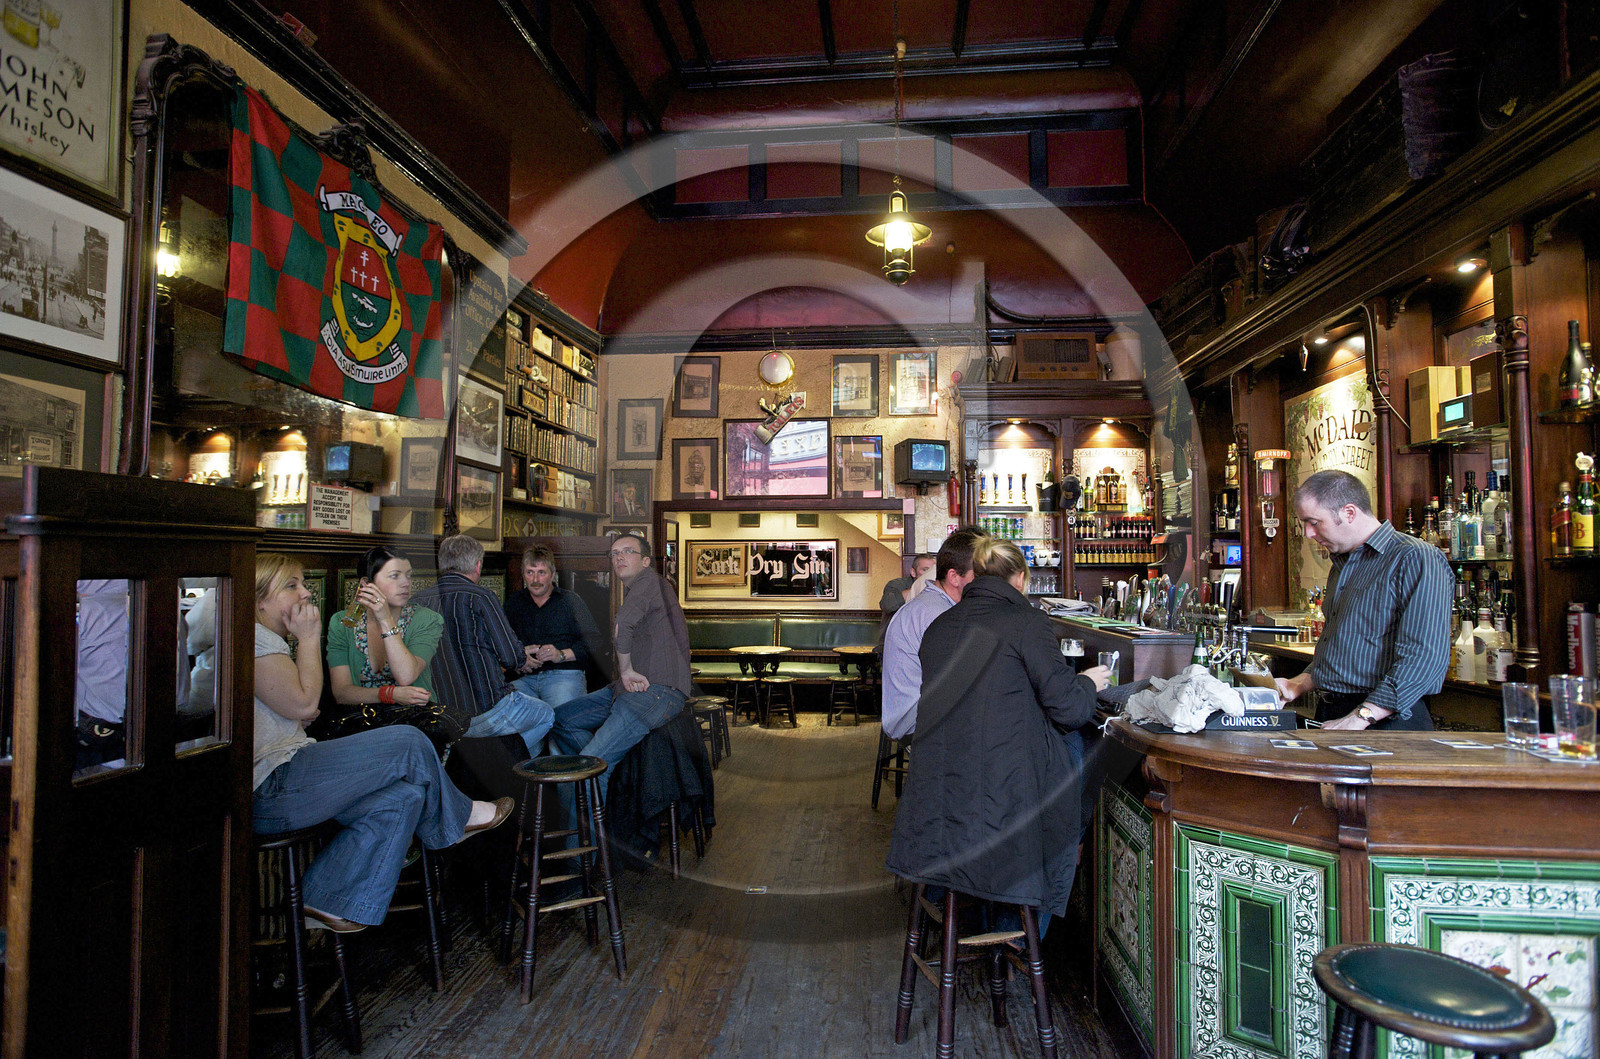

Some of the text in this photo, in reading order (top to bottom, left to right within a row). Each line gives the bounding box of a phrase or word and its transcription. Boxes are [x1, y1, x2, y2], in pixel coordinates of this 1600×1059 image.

[370, 216, 388, 236] EO
[766, 396, 804, 433] TOILETS
[1341, 445, 1373, 471] STREET
[697, 551, 826, 582] Cork Dry Gin
[1567, 615, 1580, 669] Marlboro
[1221, 715, 1268, 727] GUINNESS
